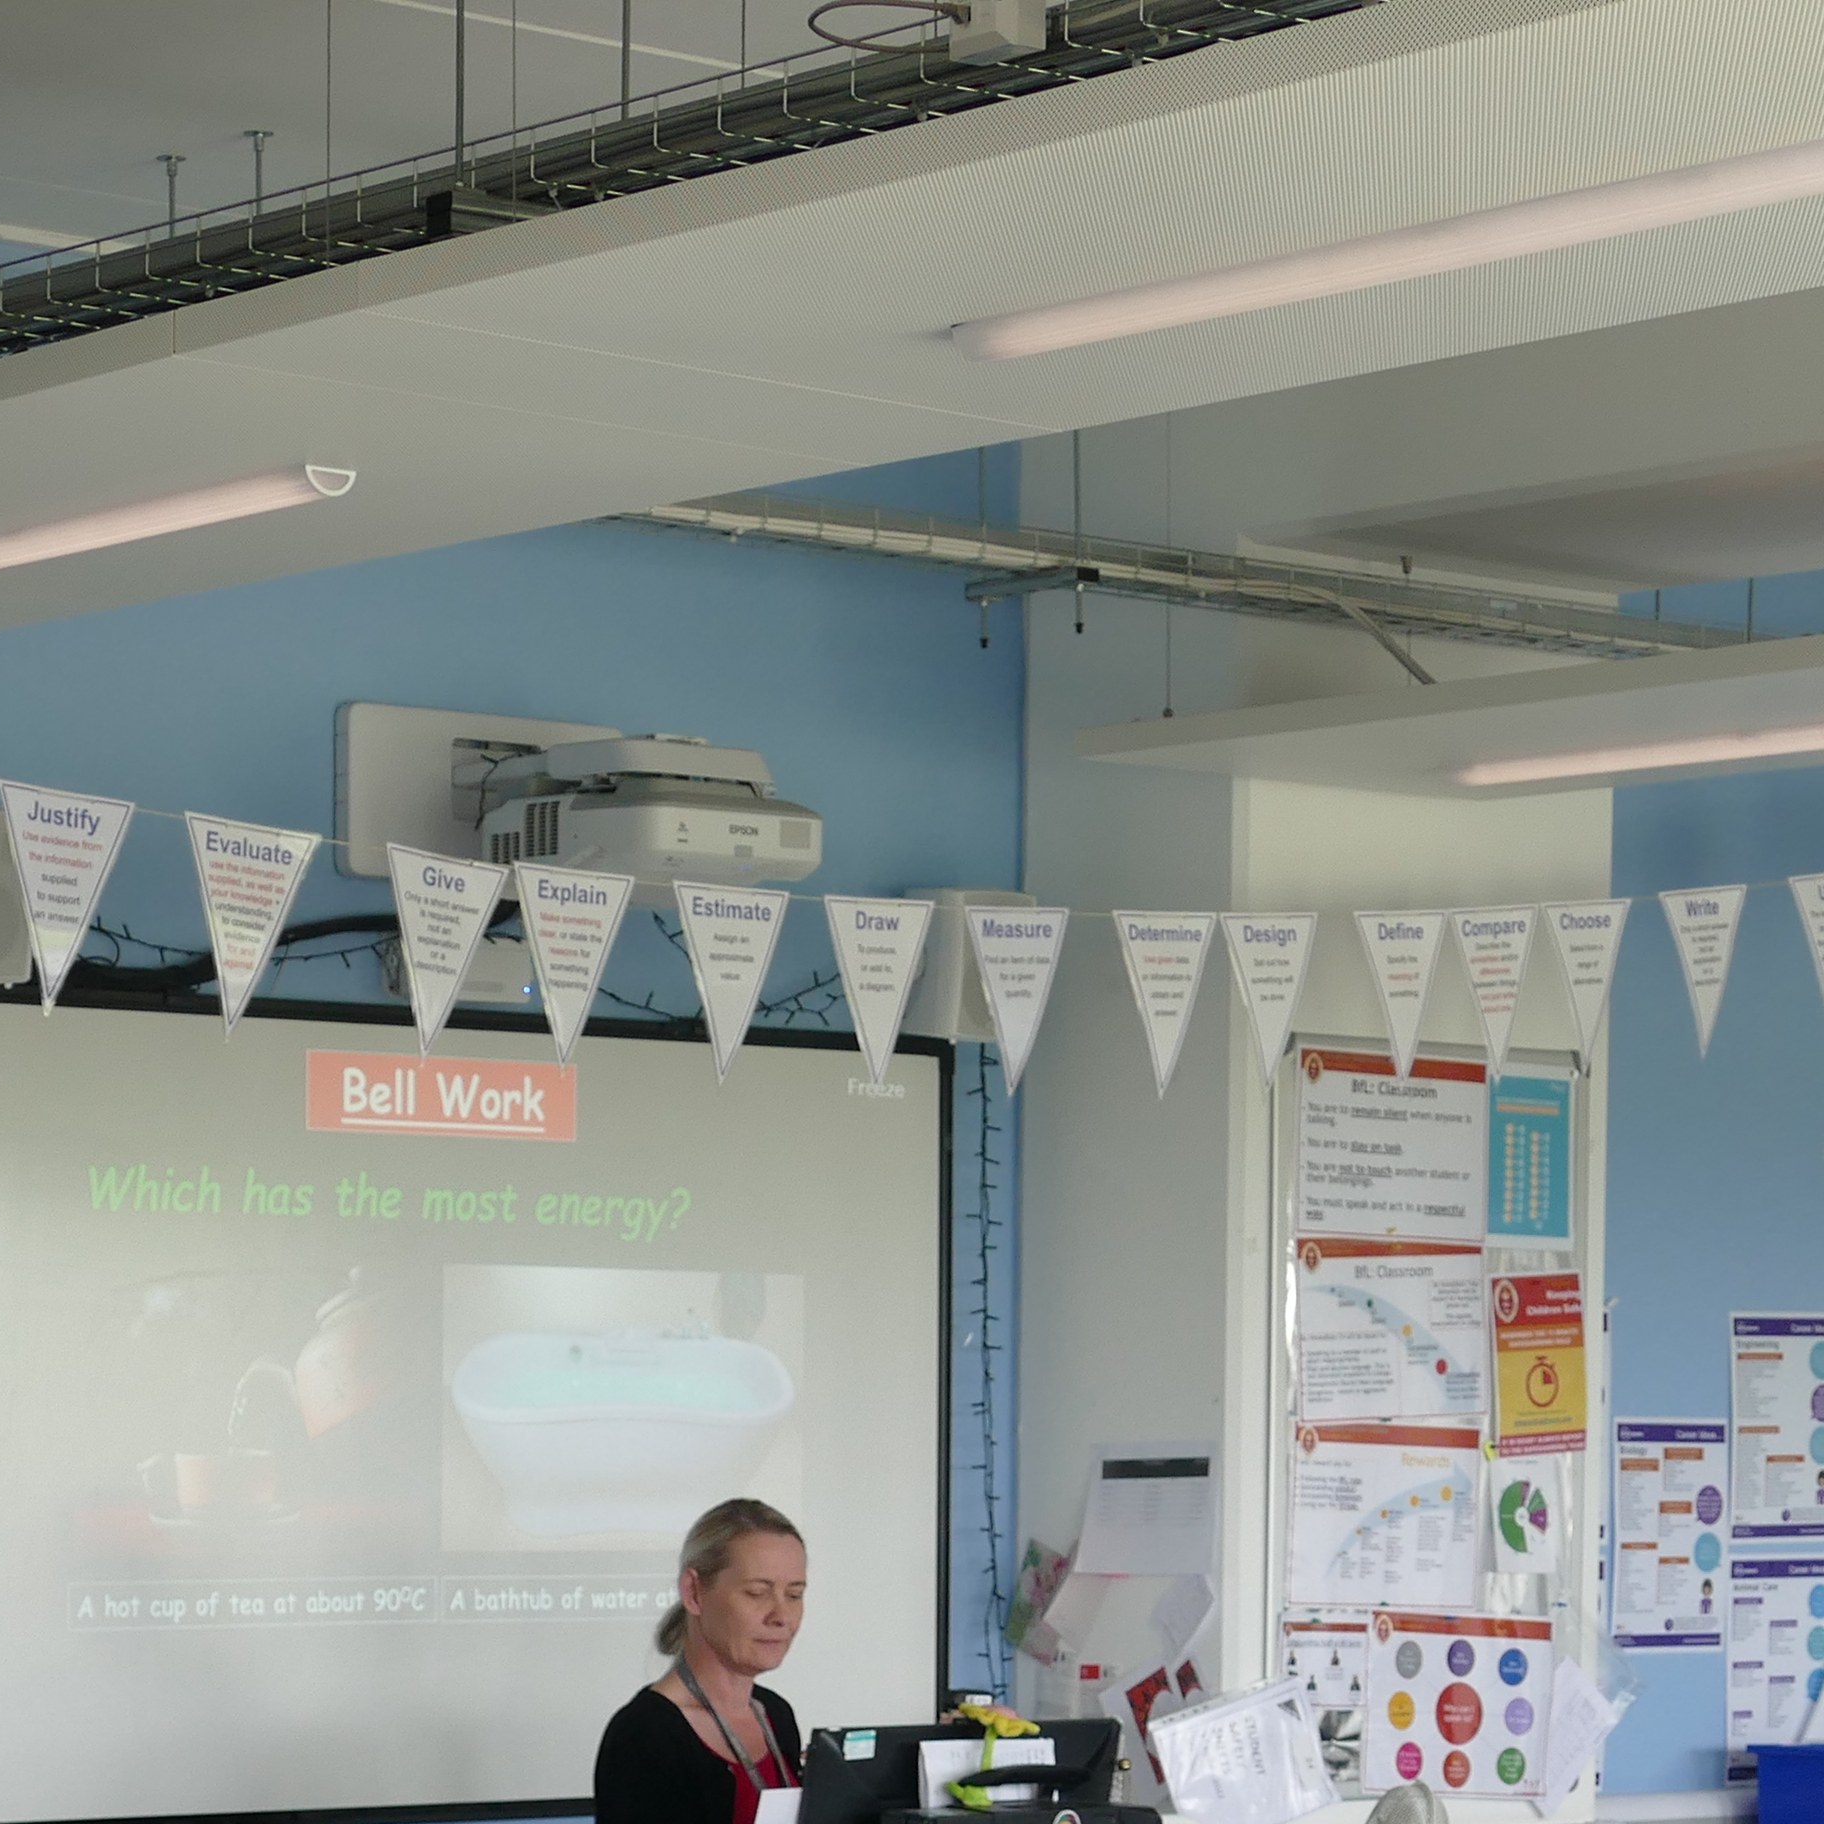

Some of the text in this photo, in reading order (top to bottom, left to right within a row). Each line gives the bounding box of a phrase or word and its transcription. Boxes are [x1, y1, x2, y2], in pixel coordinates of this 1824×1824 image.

[28, 801, 100, 836] Justify
[728, 824, 759, 836] EPSON
[206, 830, 292, 865] Evaluate
[423, 866, 465, 892] Give
[538, 879, 607, 905] Explain
[692, 896, 772, 921] Estimate
[1685, 900, 1720, 917] Write
[855, 910, 899, 931] Draw
[982, 919, 1052, 939] Measure
[1461, 919, 1526, 938] Compare
[1559, 913, 1611, 930] Choose
[1128, 924, 1202, 943] Determine
[1243, 925, 1297, 946] Design
[1378, 922, 1424, 941] Define
[342, 1066, 545, 1121] Bell Work
[87, 1164, 692, 1243] Which has the most energy?
[1377, 1265, 1434, 1278] Classroom
[76, 1594, 93, 1619] A
[104, 1592, 140, 1618] hot
[149, 1596, 186, 1623] cup
[195, 1591, 219, 1618] of
[229, 1595, 264, 1616] tea
[274, 1592, 297, 1614] at
[305, 1590, 364, 1614] about
[449, 1589, 466, 1611] A
[475, 1588, 553, 1611] bathtub
[561, 1586, 583, 1611] of
[590, 1588, 643, 1610] water
